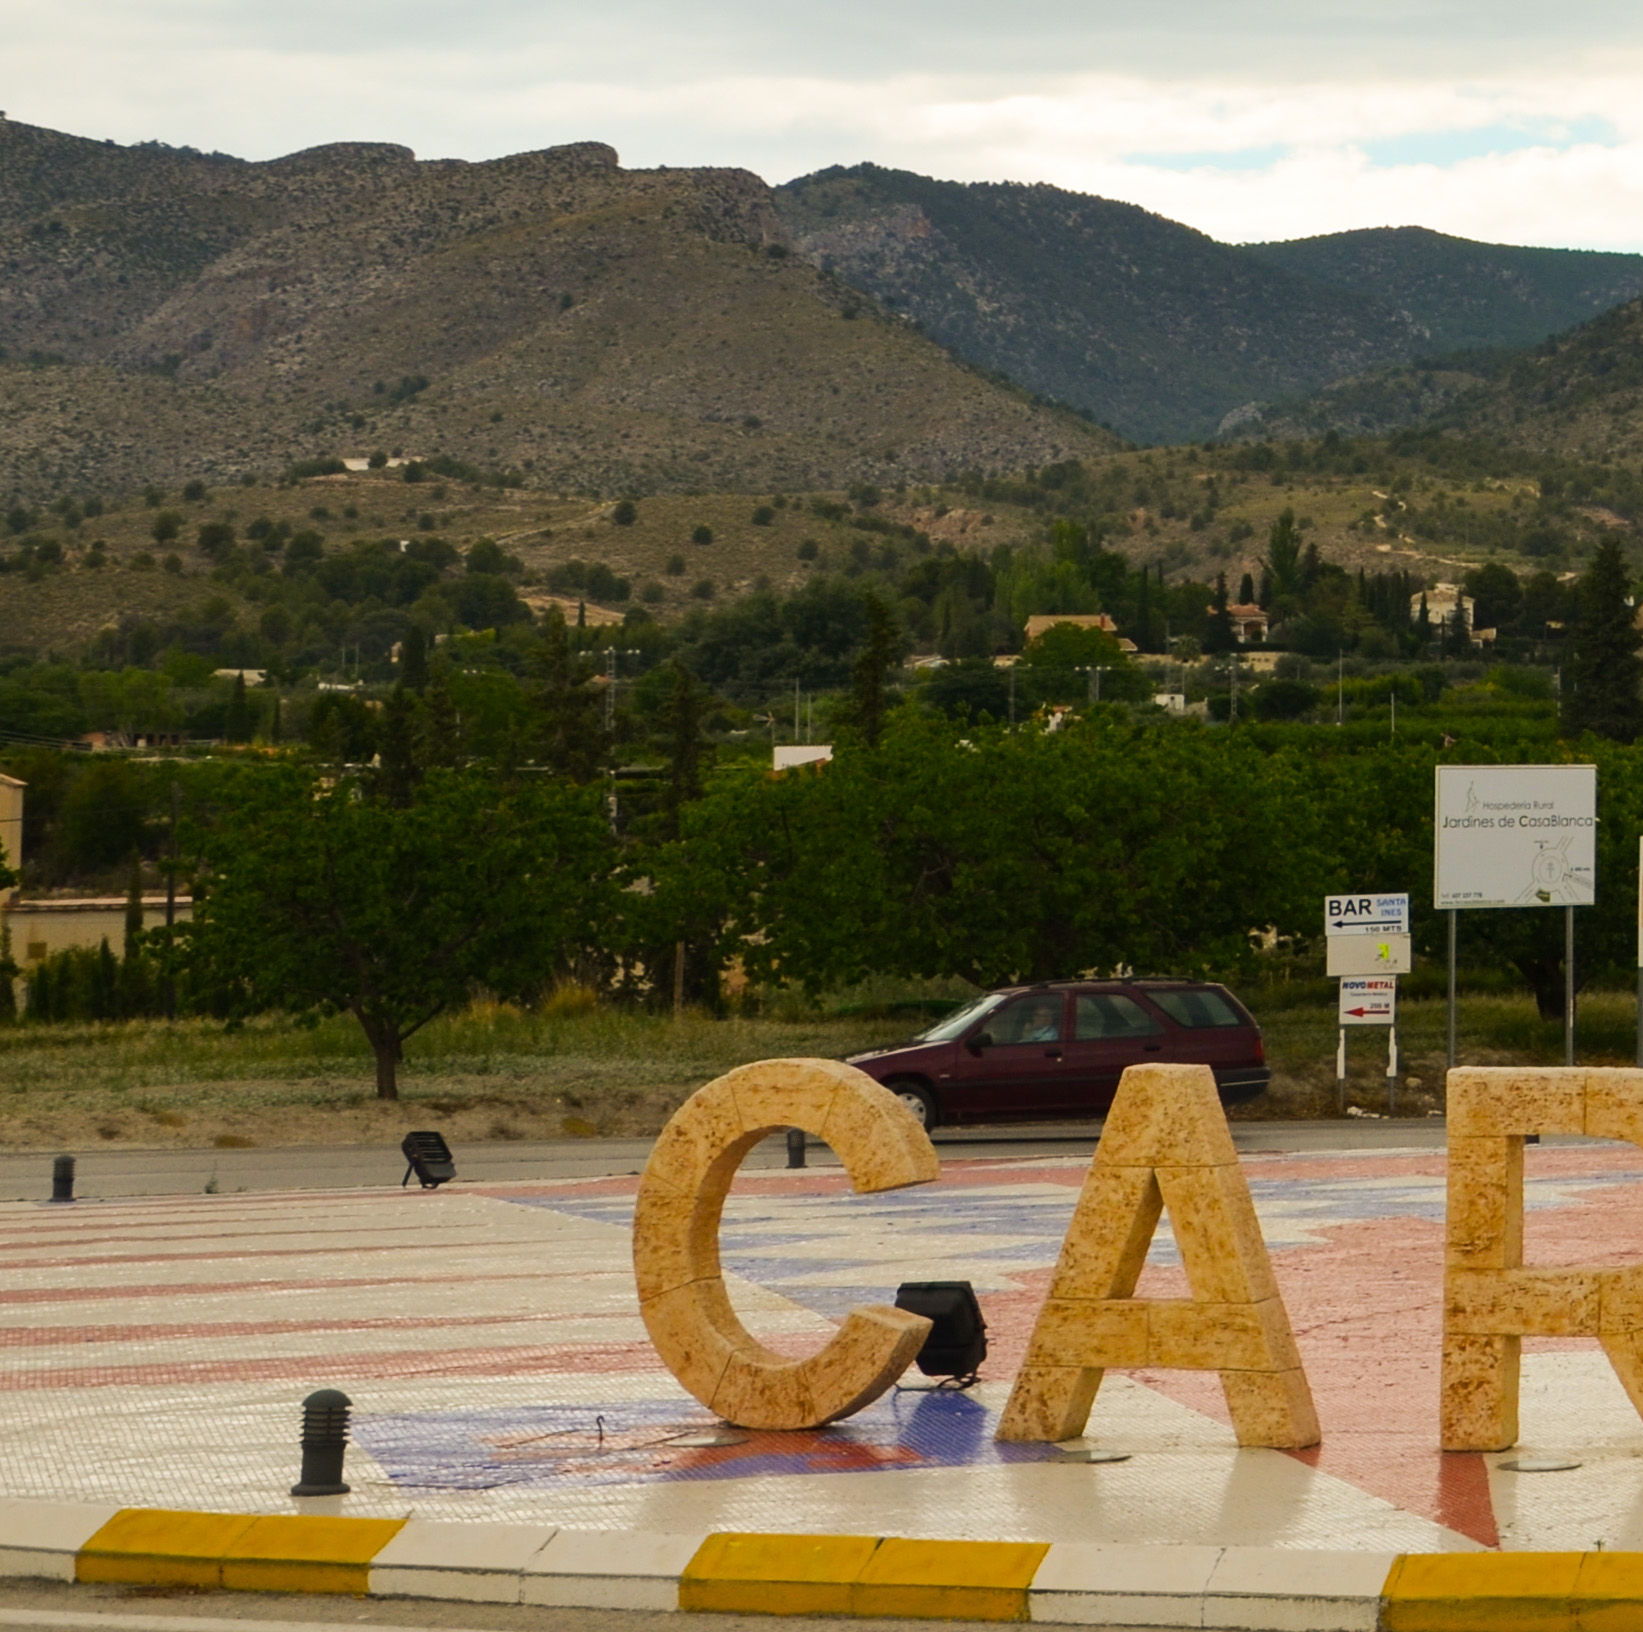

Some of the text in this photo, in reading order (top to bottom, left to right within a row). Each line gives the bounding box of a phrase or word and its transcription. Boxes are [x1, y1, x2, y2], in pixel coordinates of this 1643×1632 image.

[1443, 814, 1593, 828] Jardines de CasaBlanca
[1329, 898, 1406, 916] BAR SANTA
